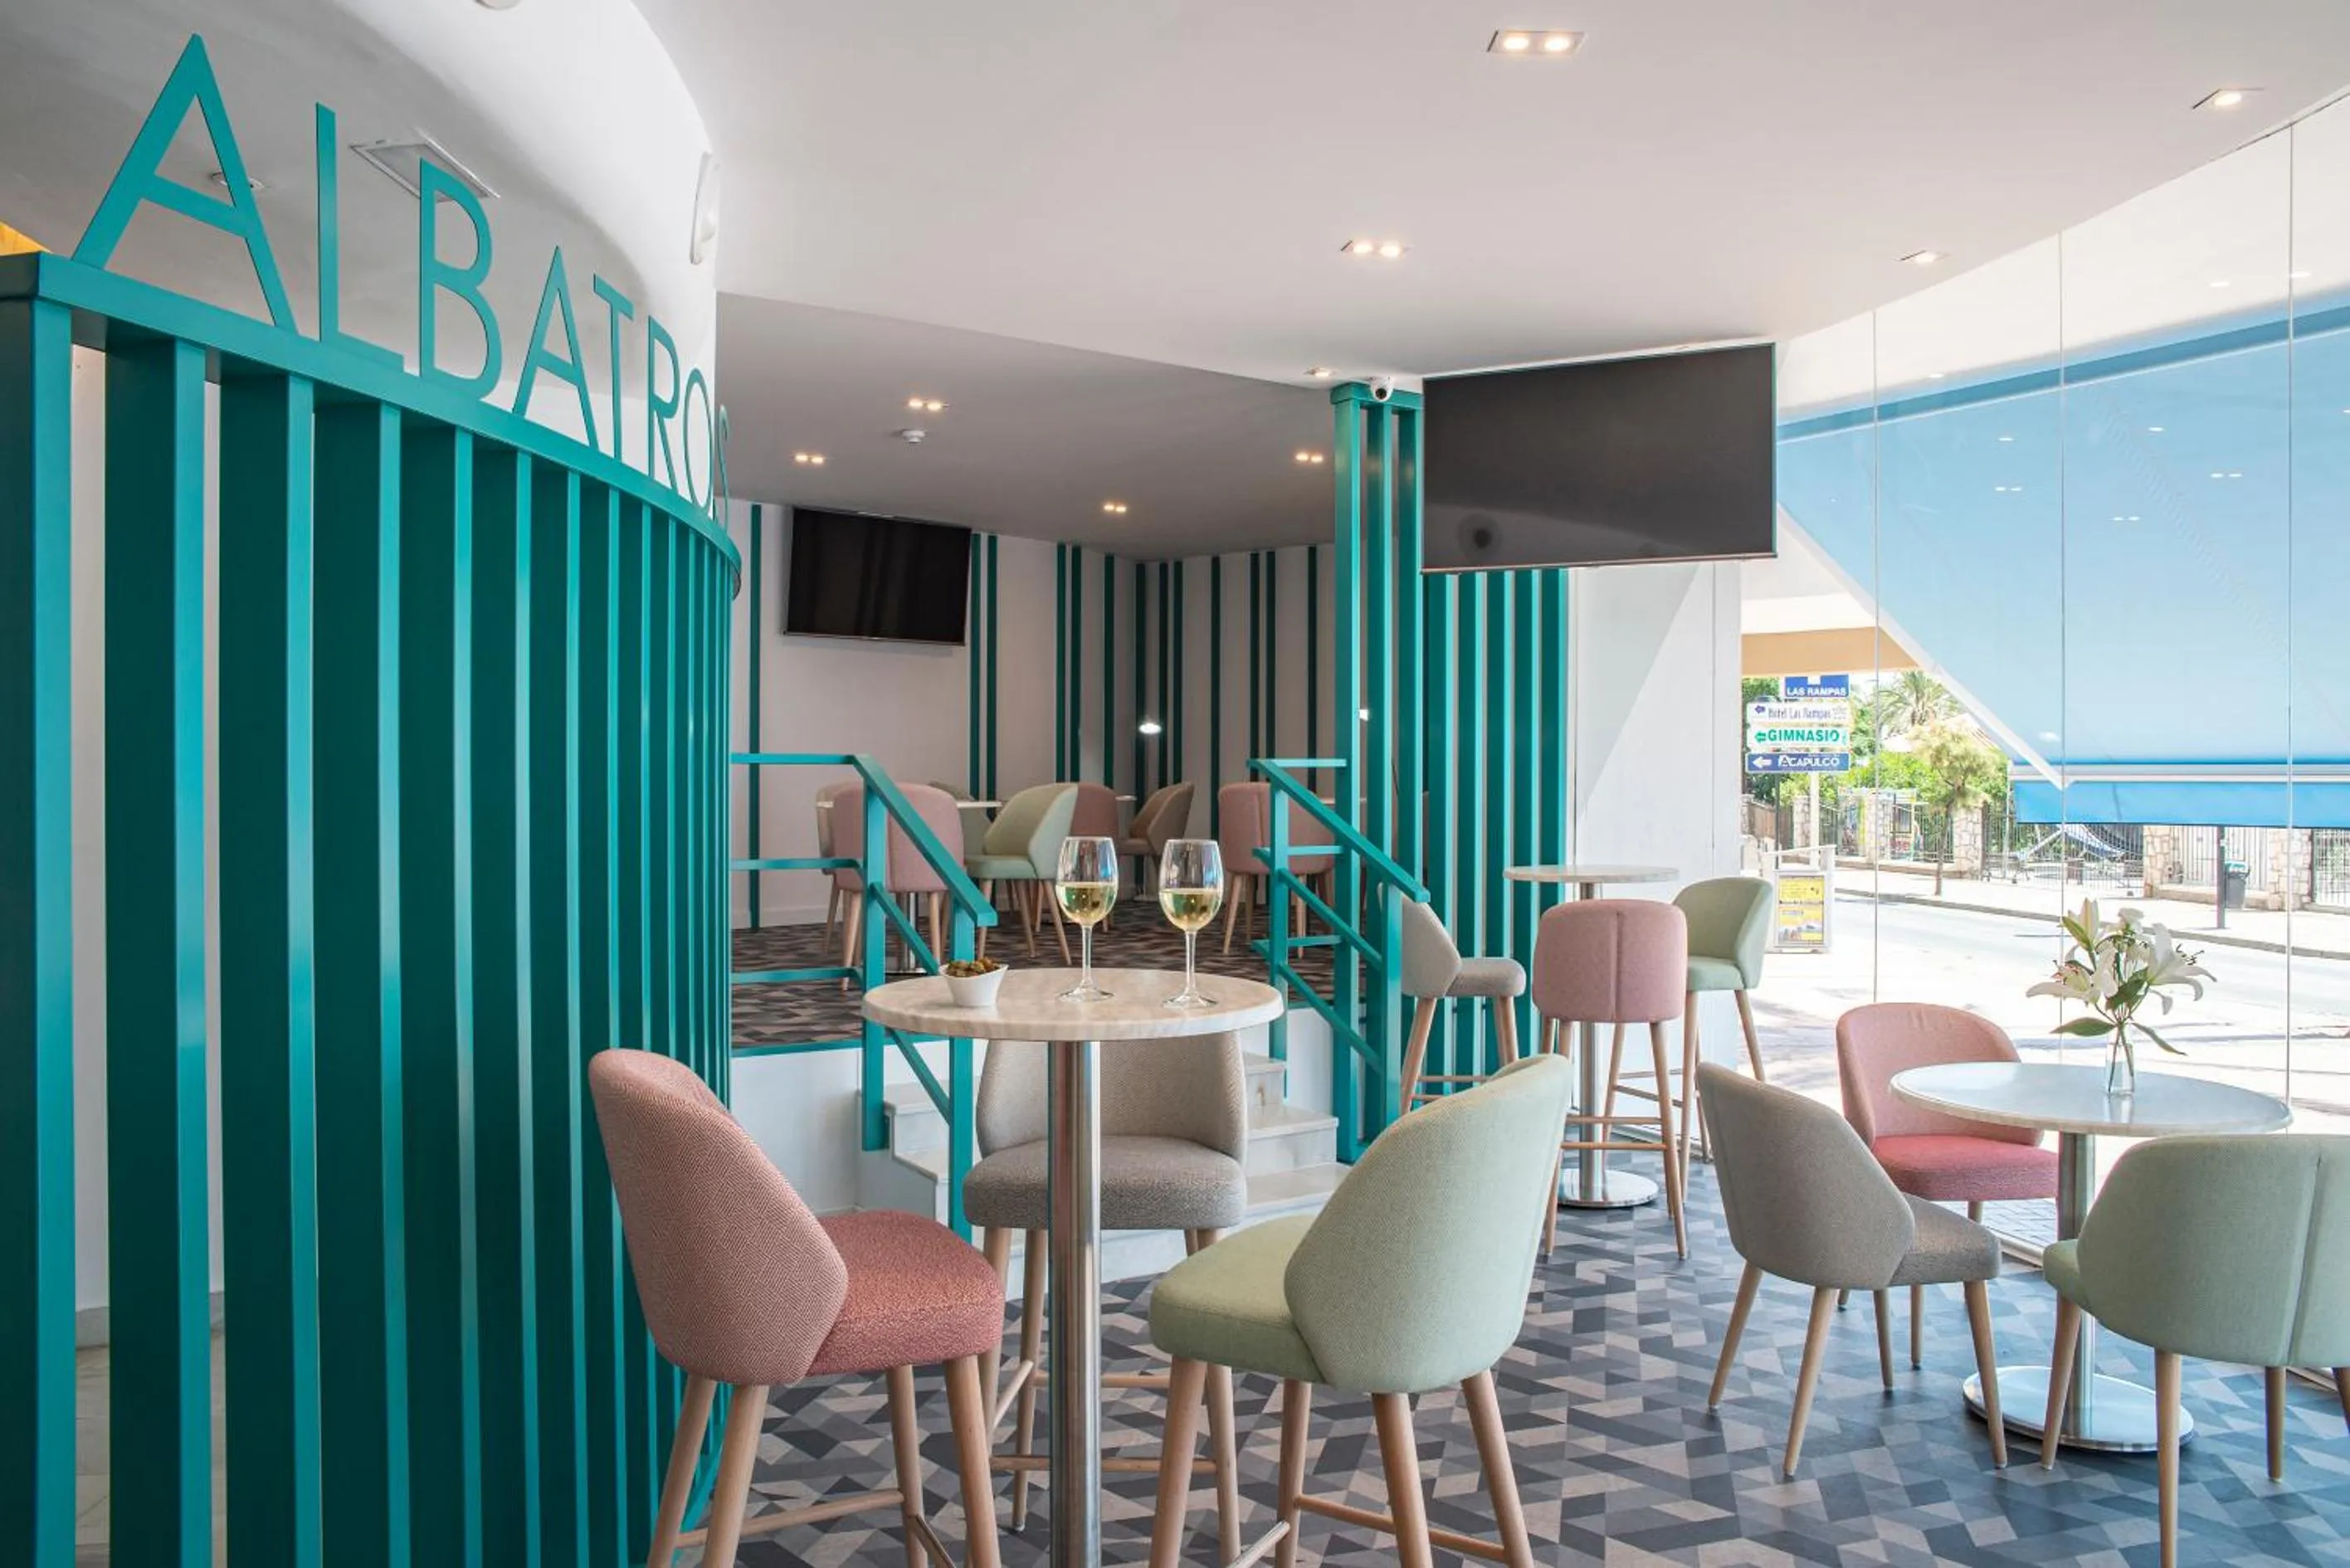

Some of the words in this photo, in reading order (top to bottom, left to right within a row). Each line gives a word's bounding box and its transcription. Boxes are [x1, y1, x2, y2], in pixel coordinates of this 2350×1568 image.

[71, 33, 729, 533] ALBATROS
[1787, 687, 1805, 696] LAS
[1807, 686, 1846, 696] RAMPAS
[1768, 707, 1786, 718] Hotel
[1768, 729, 1840, 742] GIMNASIO
[1778, 754, 1840, 767] ACAPULCO
